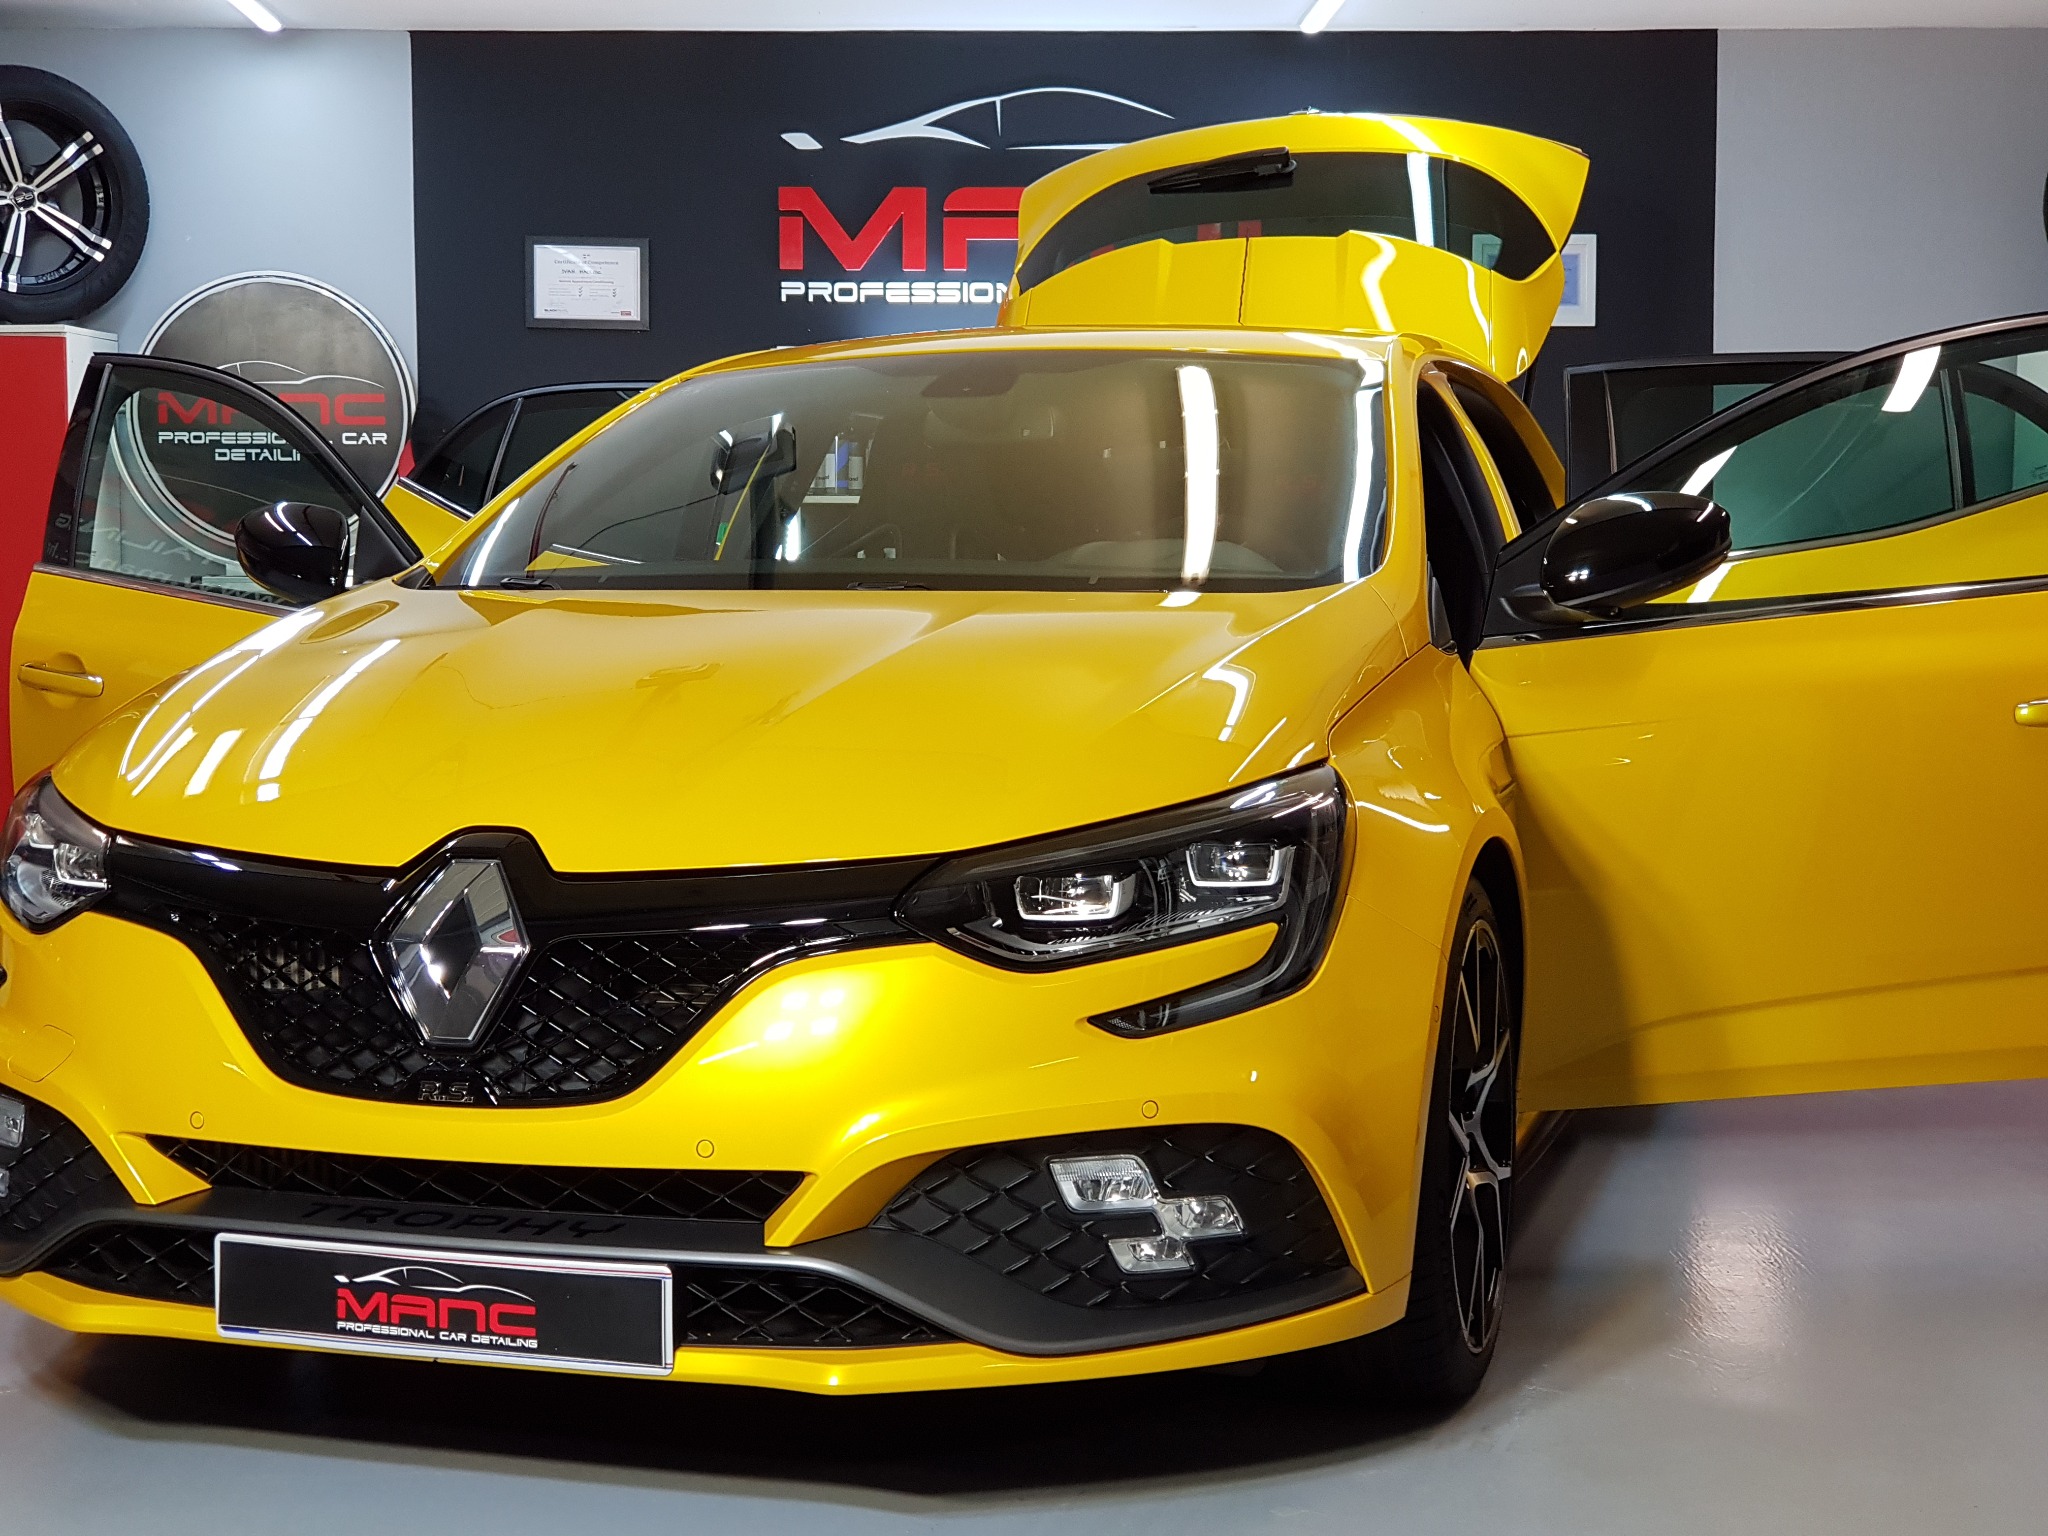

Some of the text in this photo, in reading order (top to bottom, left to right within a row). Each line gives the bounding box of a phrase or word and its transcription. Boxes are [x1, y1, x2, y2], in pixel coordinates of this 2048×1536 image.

[780, 281, 1009, 303] PROFESSIO
[158, 431, 388, 445] PROFESSIO CAR
[215, 448, 301, 462] DETAILI
[302, 1202, 626, 1237] TROPHY
[337, 1288, 537, 1337] MANC
[336, 1321, 538, 1349] PROFESSIONAL CAR DETAILING
